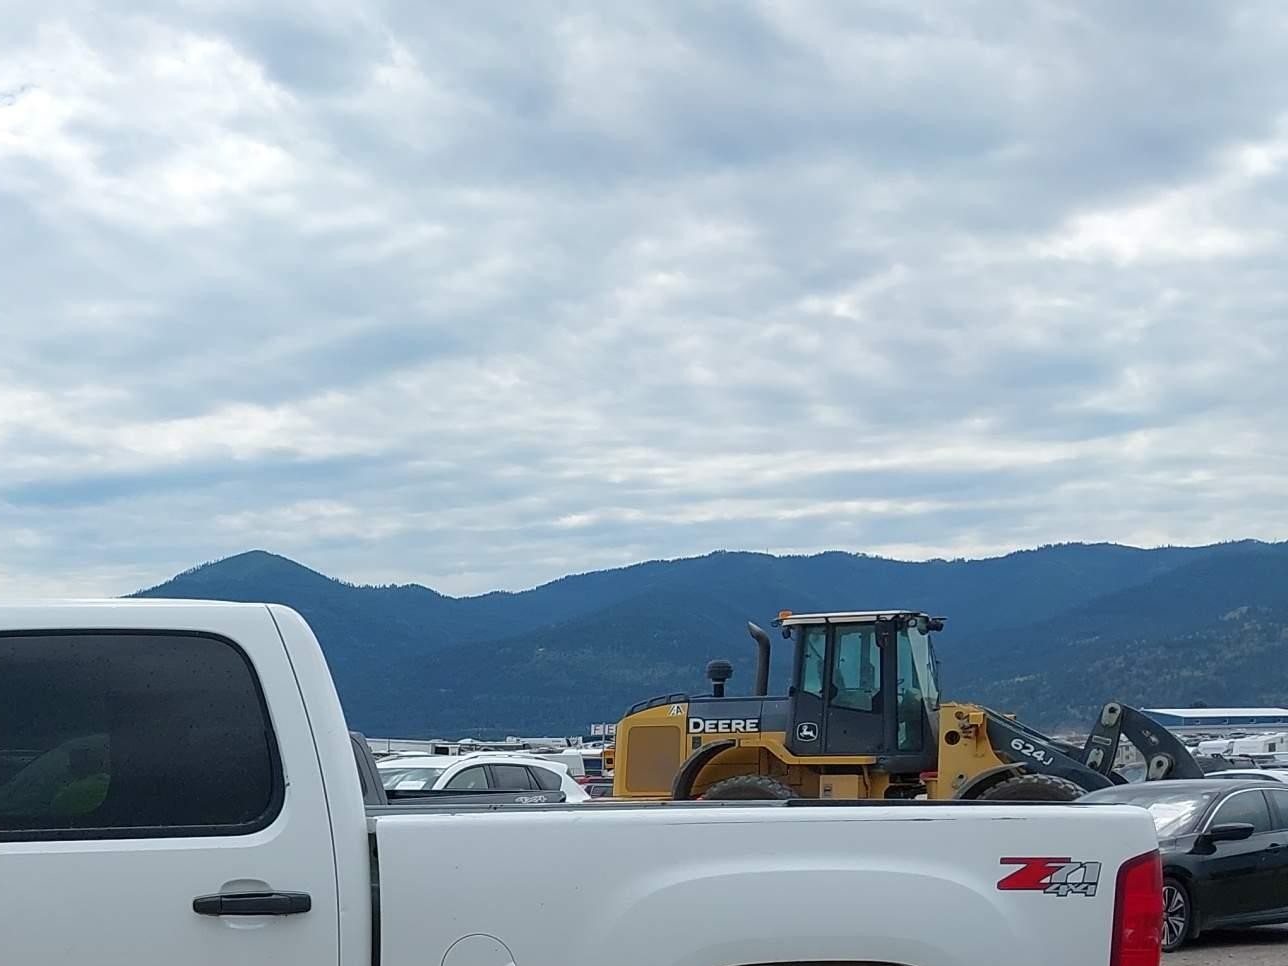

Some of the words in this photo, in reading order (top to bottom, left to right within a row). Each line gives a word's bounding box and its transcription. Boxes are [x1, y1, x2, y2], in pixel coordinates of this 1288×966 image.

[688, 718, 759, 733] DEERE
[1010, 738, 1054, 766] 624J
[997, 857, 1101, 890] Z71
[1043, 882, 1098, 896] 4x4
